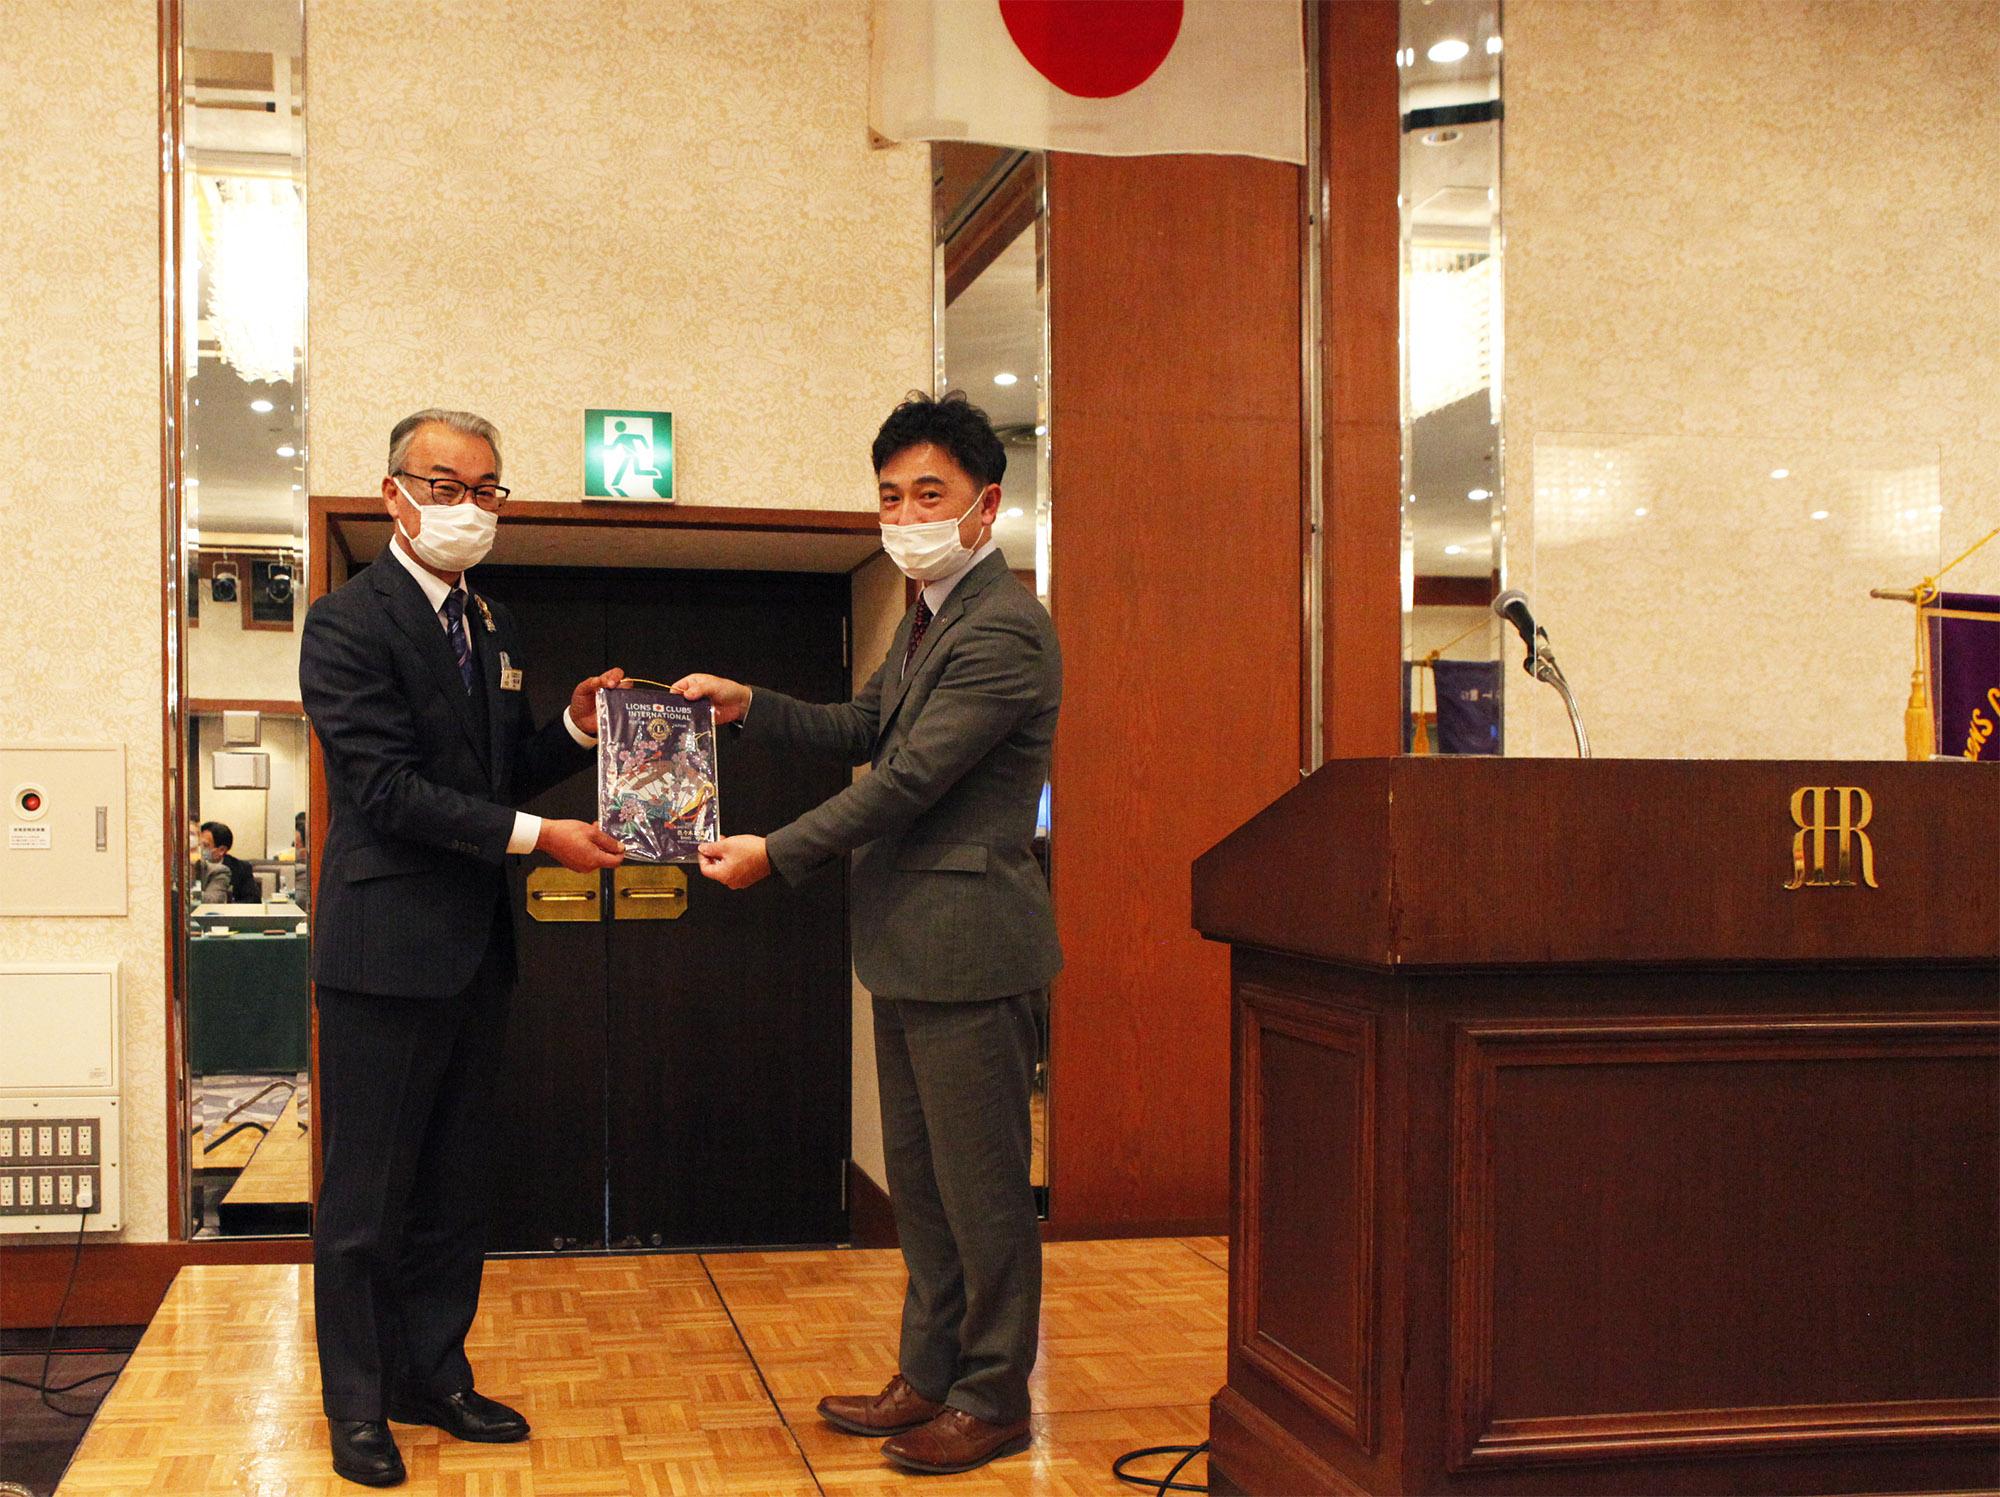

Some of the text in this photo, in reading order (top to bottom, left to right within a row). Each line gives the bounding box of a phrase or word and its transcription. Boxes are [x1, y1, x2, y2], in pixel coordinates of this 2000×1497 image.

[625, 703, 692, 714] LIONS CLUBS
[628, 711, 691, 720] INTERNATIONAL
